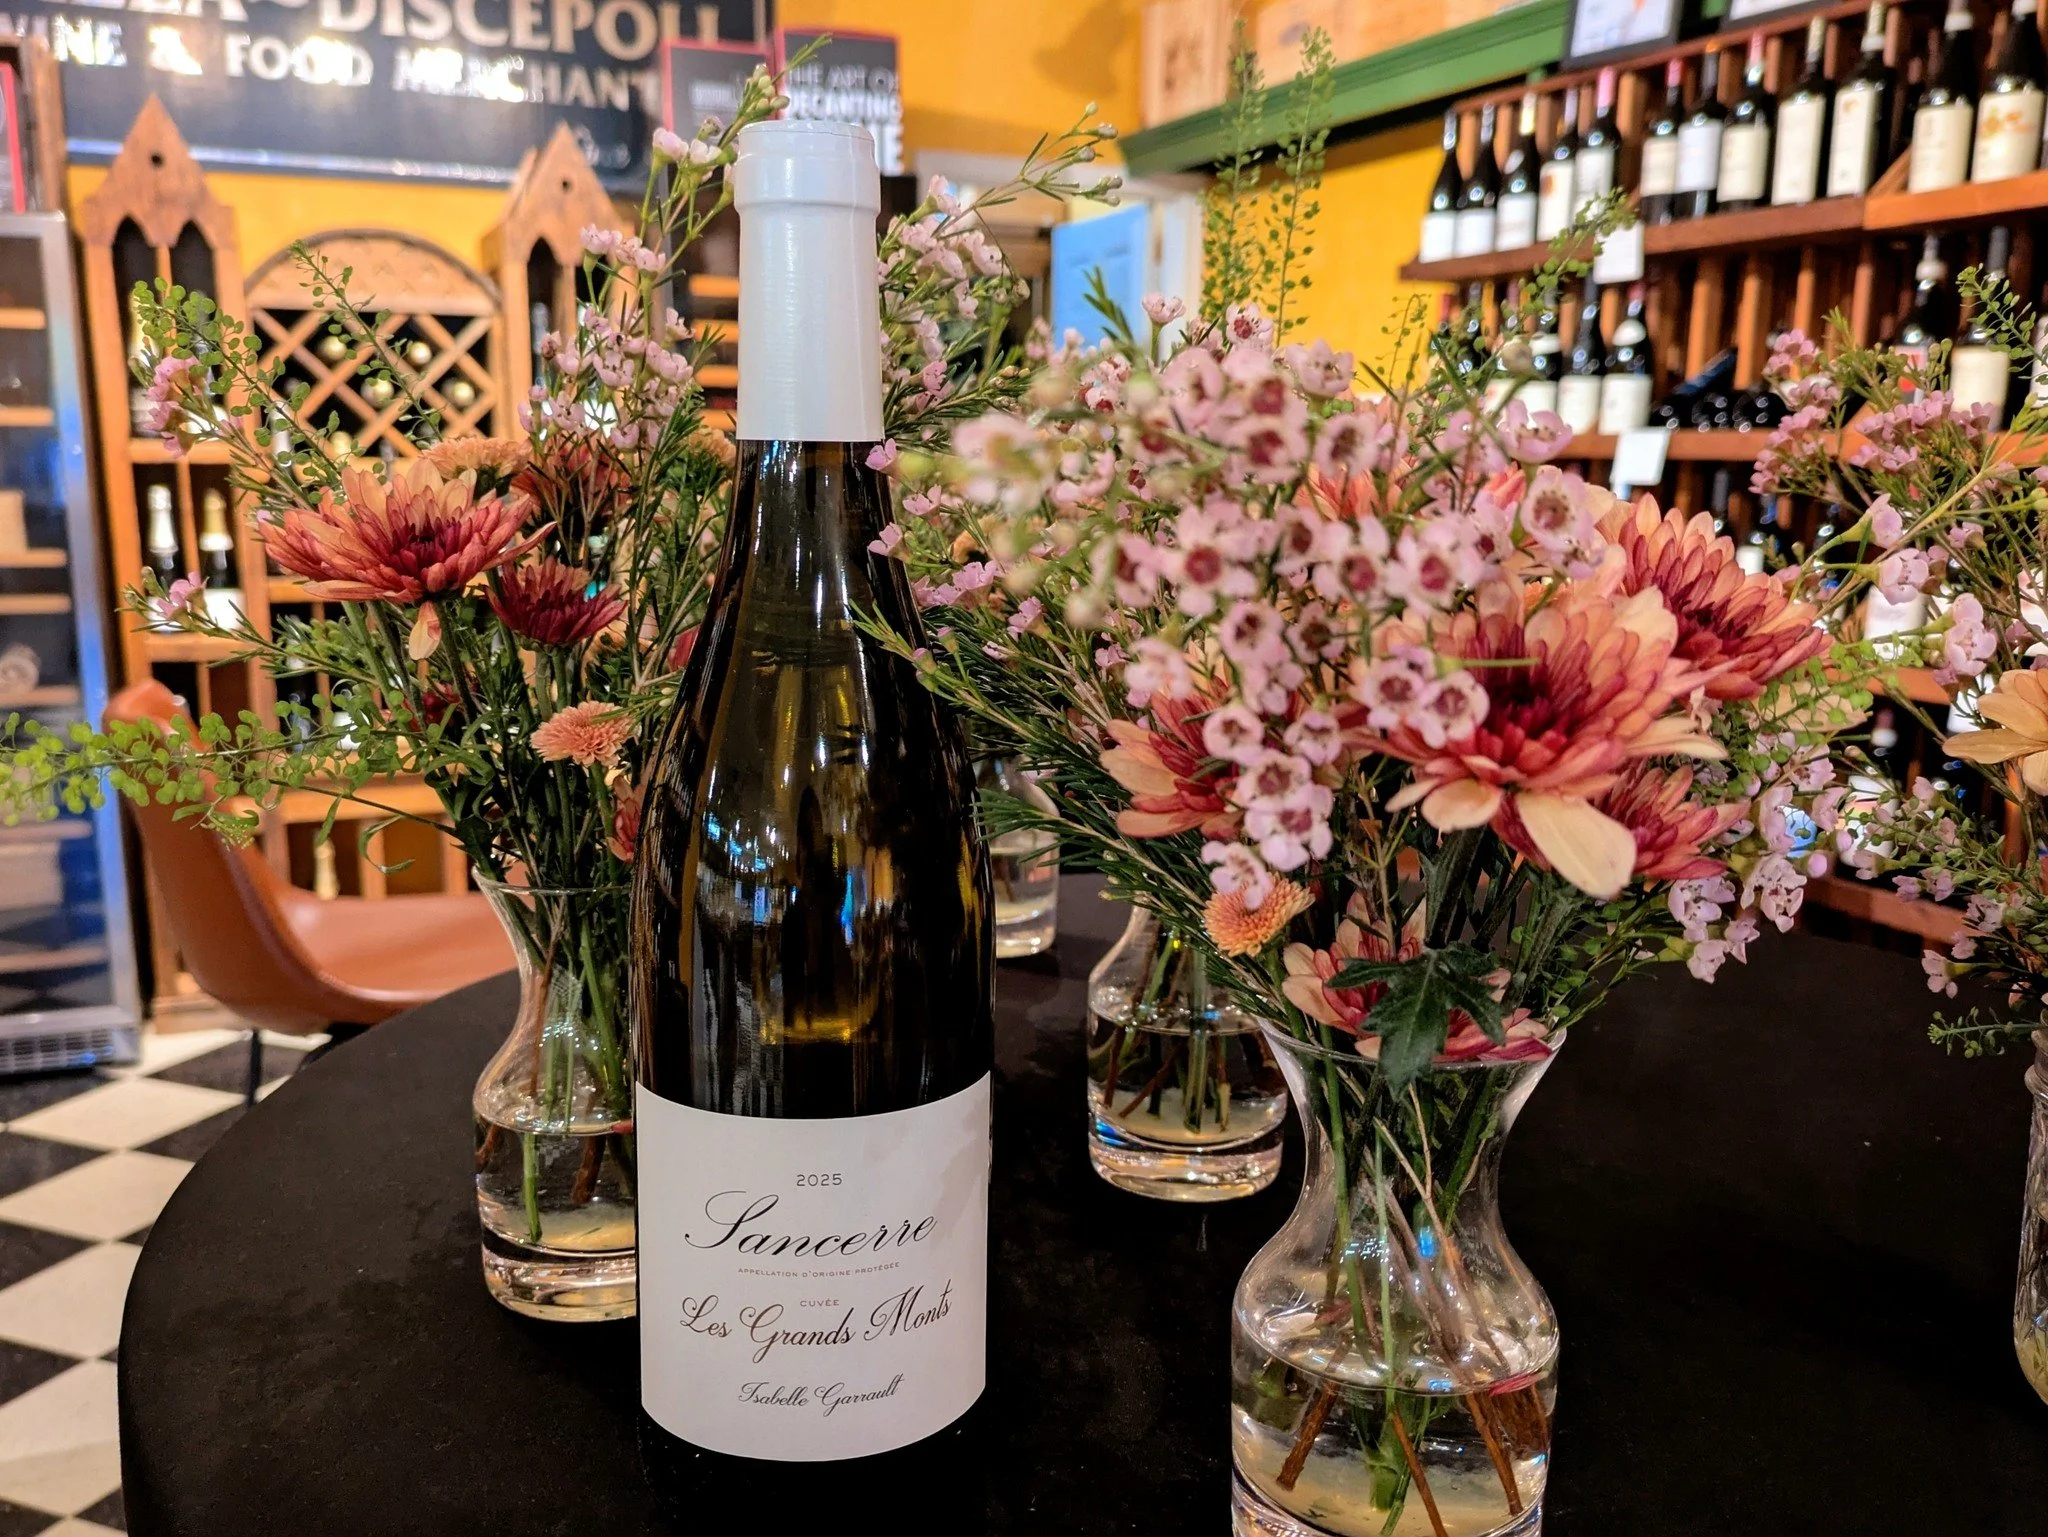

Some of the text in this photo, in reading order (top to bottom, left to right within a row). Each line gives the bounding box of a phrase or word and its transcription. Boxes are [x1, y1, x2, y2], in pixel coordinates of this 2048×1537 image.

[225, 32, 374, 86] FOOD
[796, 1173, 843, 1187] 2025
[685, 1191, 938, 1258] Sancerre
[738, 1261, 900, 1278] APPELLATION D'ORIGINE PROTÉGÉE
[680, 1279, 953, 1364] Les Grands Monts
[800, 1299, 840, 1307] CUVÉE
[738, 1373, 905, 1417] Isabelle Garrault
